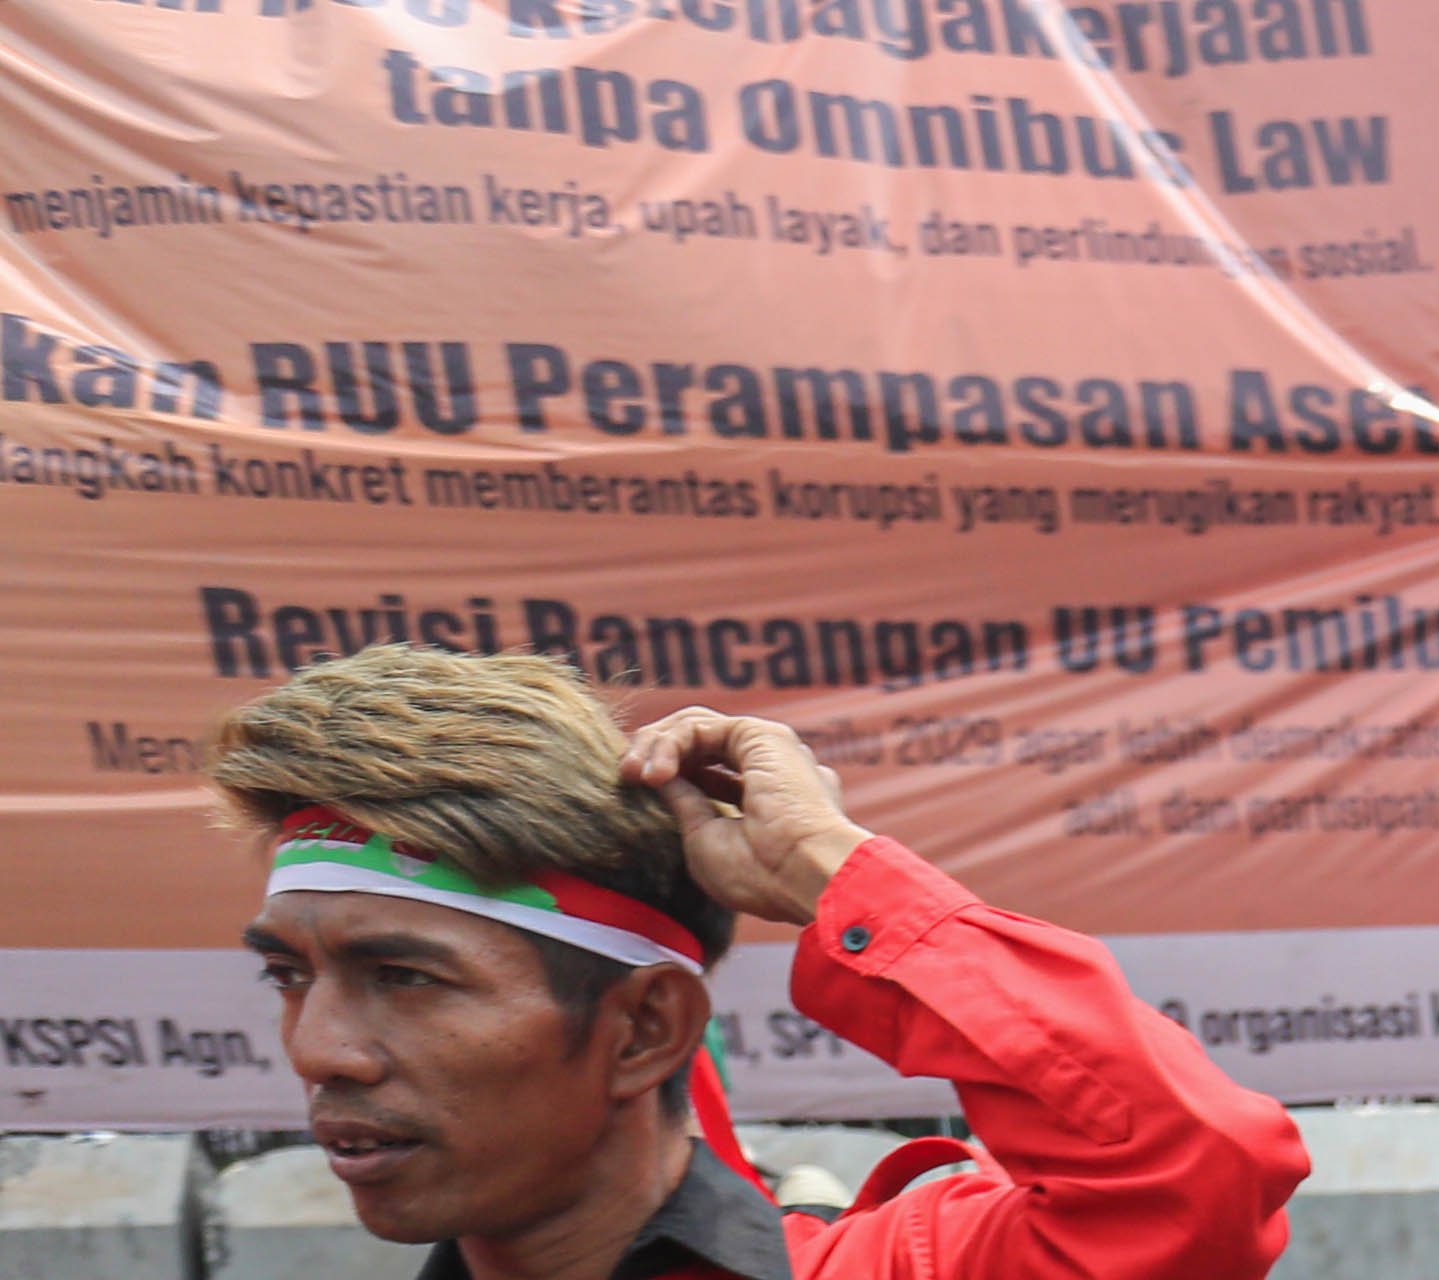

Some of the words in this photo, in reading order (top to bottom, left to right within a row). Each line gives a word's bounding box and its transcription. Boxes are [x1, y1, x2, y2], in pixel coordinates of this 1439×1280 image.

[384, 50, 711, 153] tanpa
[1208, 110, 1389, 196] Law
[5, 174, 223, 239] menjamin
[230, 170, 474, 233] kepastian
[638, 191, 758, 244] upah
[918, 211, 1003, 257] dan
[247, 341, 481, 436] RUU
[505, 341, 1203, 454] Perampasan
[208, 443, 413, 507] konkret
[423, 460, 760, 521] memberantas
[769, 467, 942, 531] korupsi
[950, 484, 1060, 534] yang
[1069, 478, 1297, 535] merugikan
[201, 586, 499, 680] Revisi
[1052, 604, 1157, 675] UU
[1200, 996, 1422, 1054] organisasi
